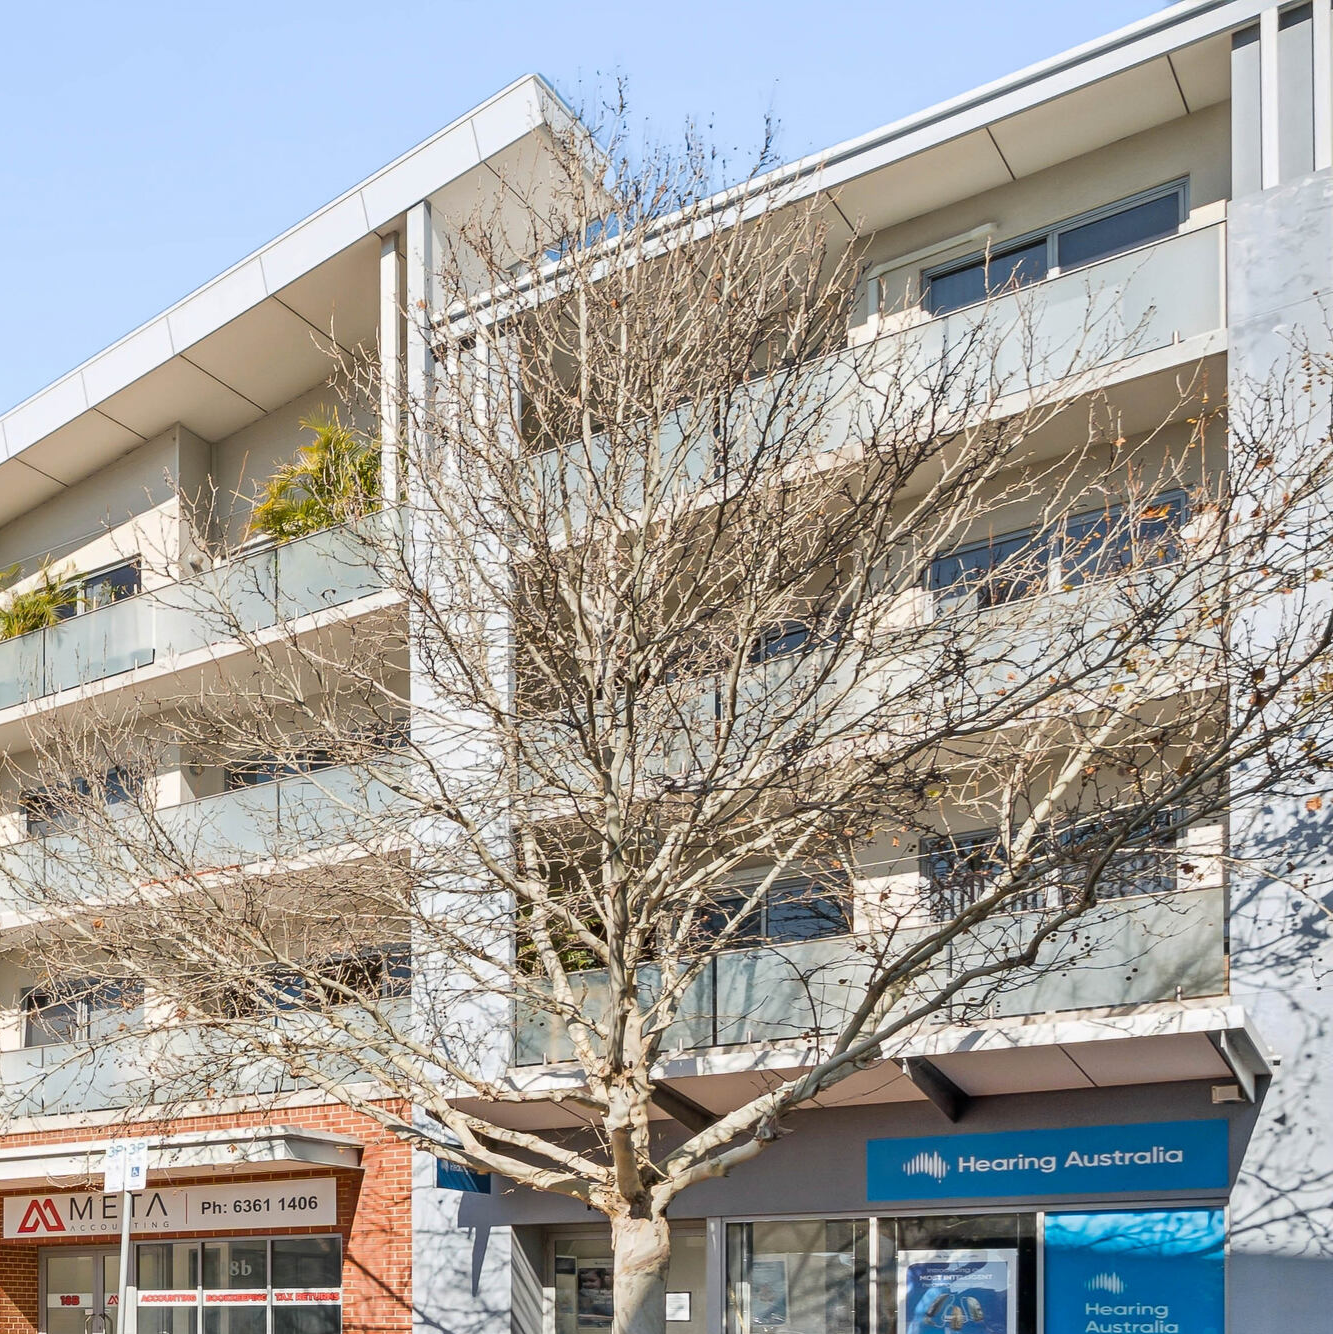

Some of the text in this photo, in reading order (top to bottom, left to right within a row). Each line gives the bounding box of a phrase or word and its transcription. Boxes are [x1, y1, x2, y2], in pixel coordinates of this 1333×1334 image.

[958, 1146, 1184, 1173] Hearing Australia
[69, 1192, 168, 1221] META
[201, 1196, 318, 1215] Ph: 6361 1406
[70, 1220, 170, 1232] ACCOUTING
[141, 1293, 197, 1303] ACCOUNTING
[205, 1293, 267, 1303] BOOKKEEPING
[274, 1291, 340, 1302] TAX RETURNS
[1085, 1302, 1169, 1319] Hearing
[1085, 1320, 1179, 1334] Australia
